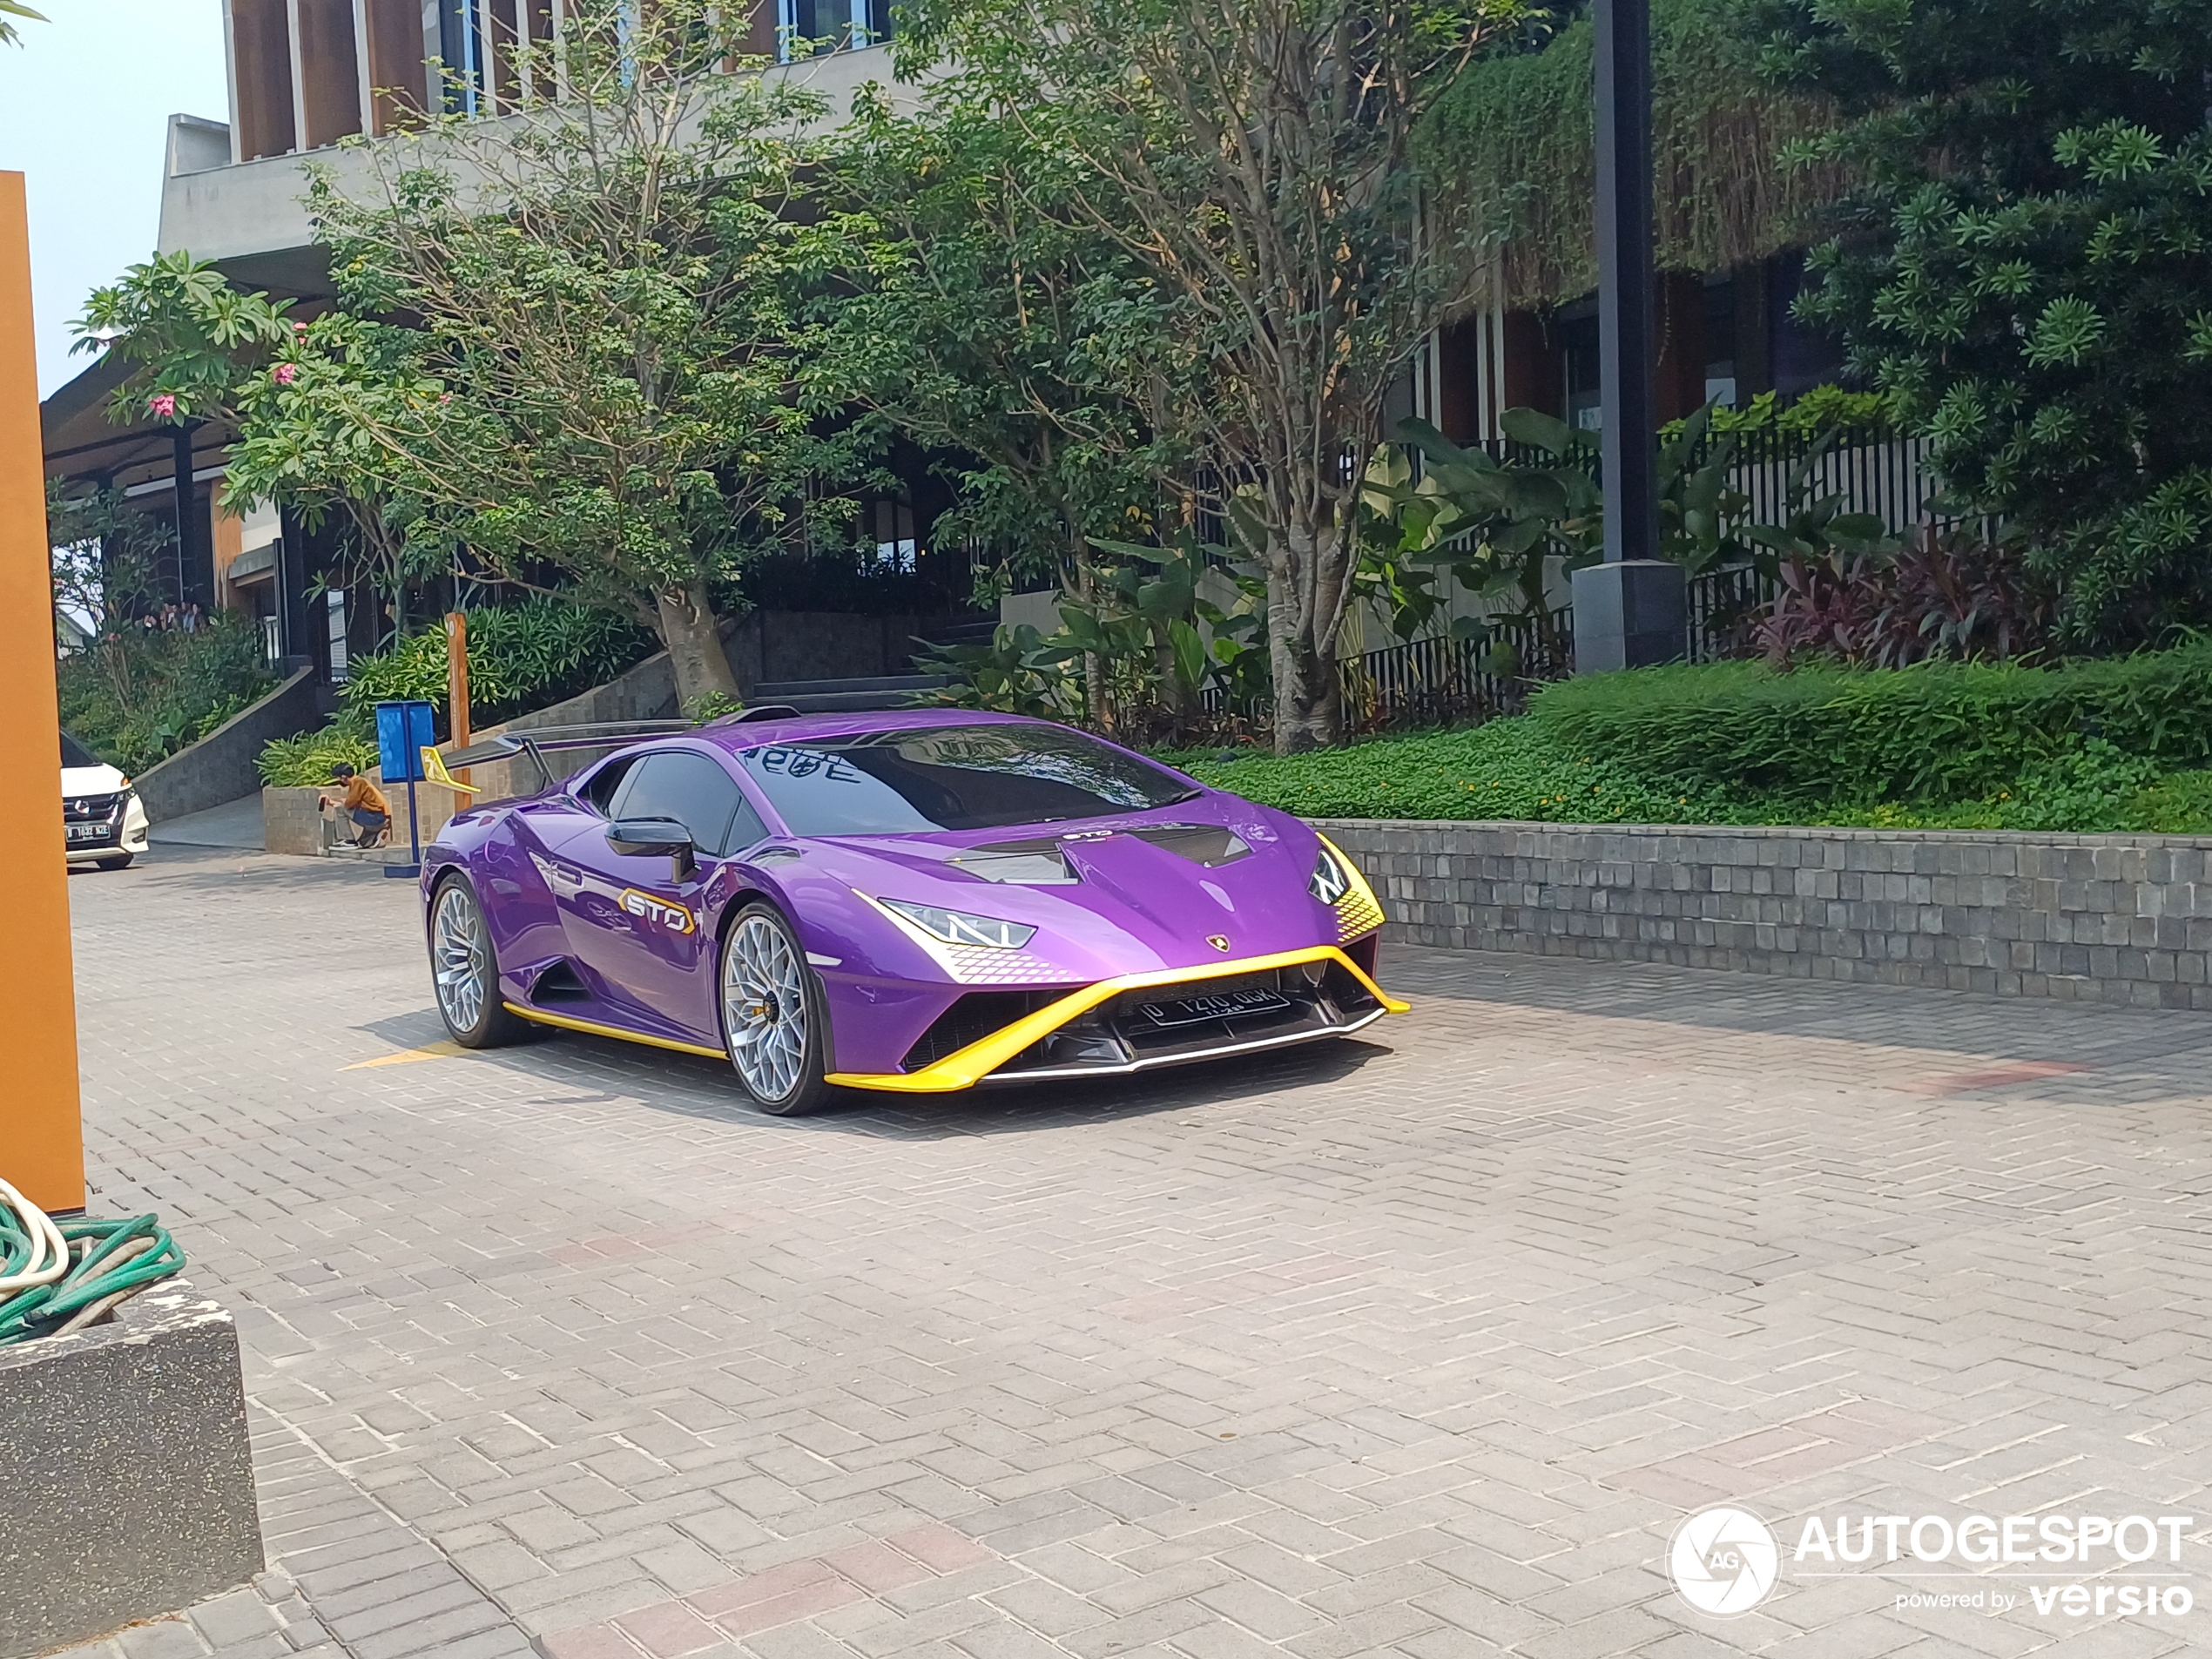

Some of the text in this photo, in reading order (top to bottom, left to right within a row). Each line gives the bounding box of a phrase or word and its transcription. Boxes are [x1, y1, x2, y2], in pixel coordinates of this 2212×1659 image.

[626, 894, 685, 931] STO
[1143, 1003, 1164, 1017] D
[1176, 995, 1231, 1013] 1270
[1232, 988, 1278, 1004] QGK
